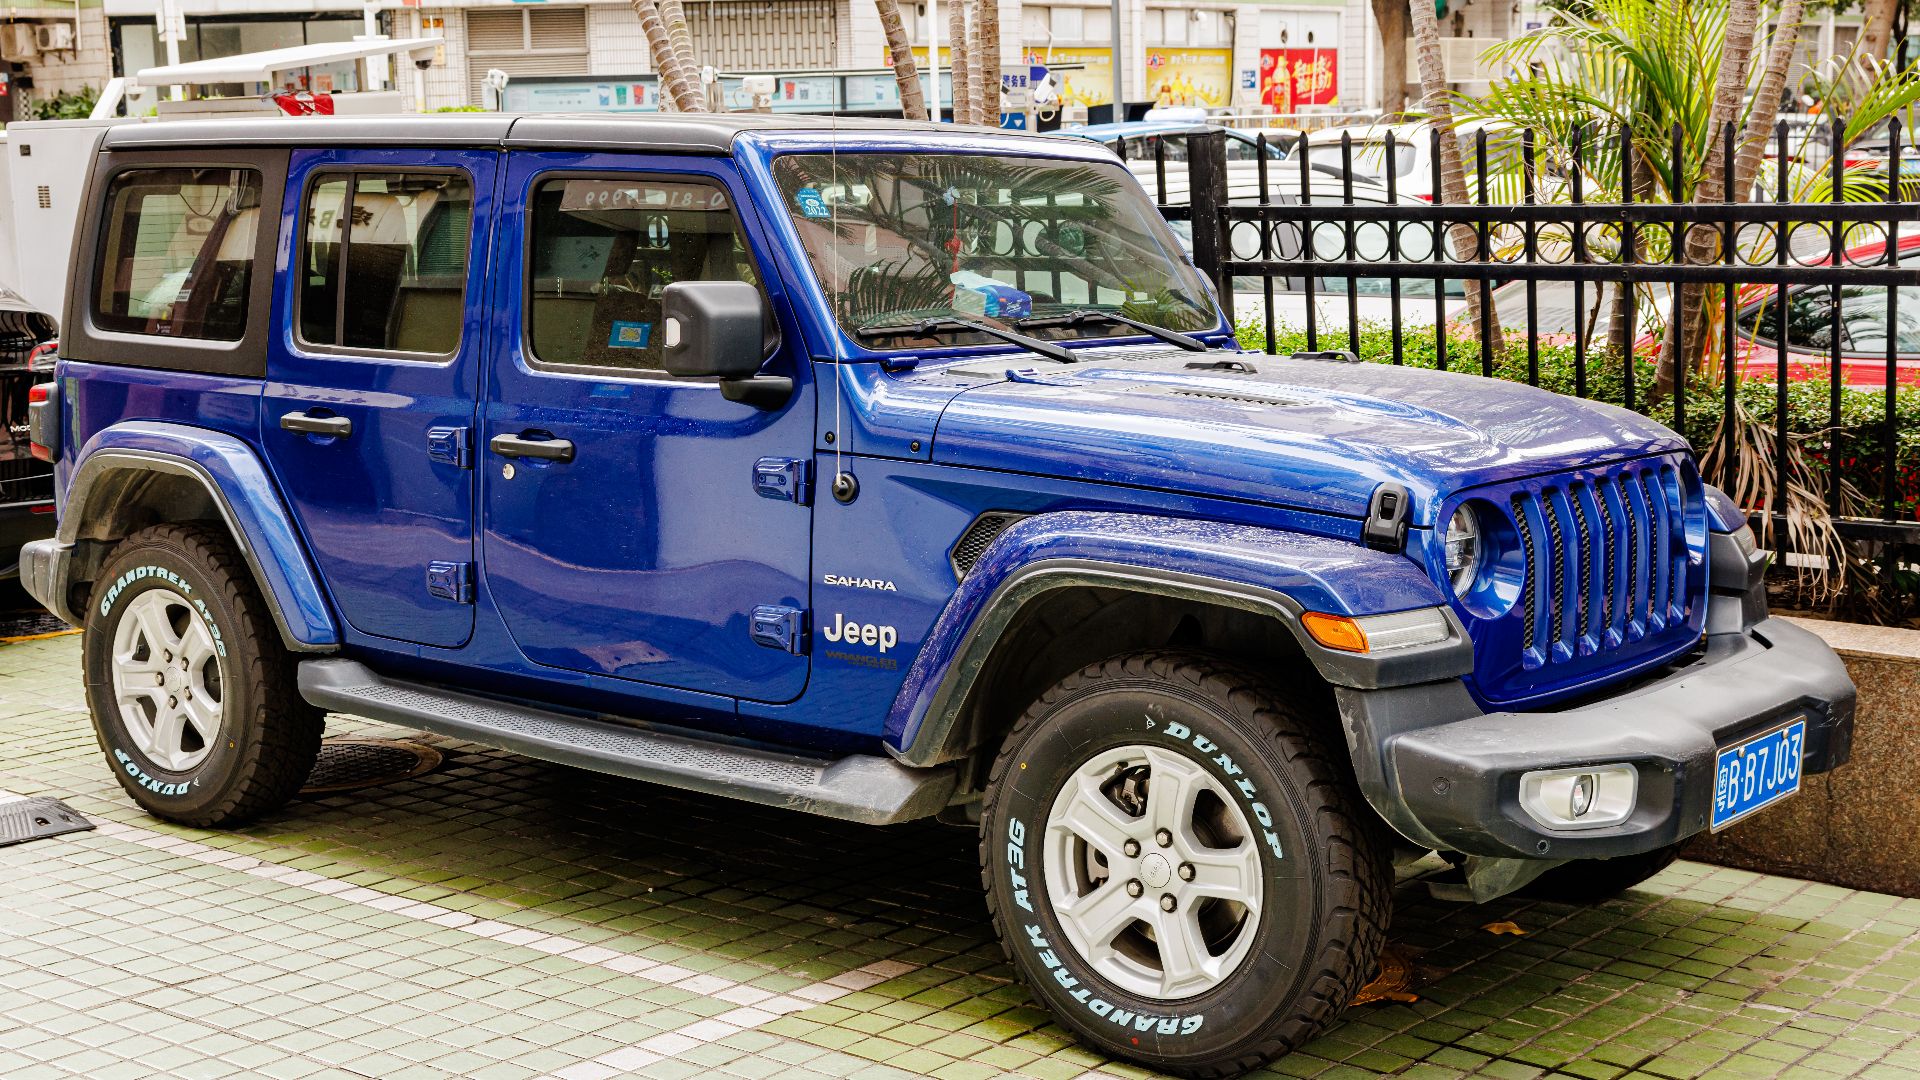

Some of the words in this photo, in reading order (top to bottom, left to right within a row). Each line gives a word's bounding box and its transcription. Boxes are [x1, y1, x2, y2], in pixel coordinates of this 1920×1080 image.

[100, 565, 192, 617] GRANDTREK
[823, 574, 897, 592] SAHARA
[823, 613, 898, 653] Jeep
[114, 748, 191, 796] DUNLOP
[1162, 720, 1284, 860] DUNLOP
[1007, 817, 1034, 913] AT3G
[1024, 924, 1204, 1035] GRANDTREK
